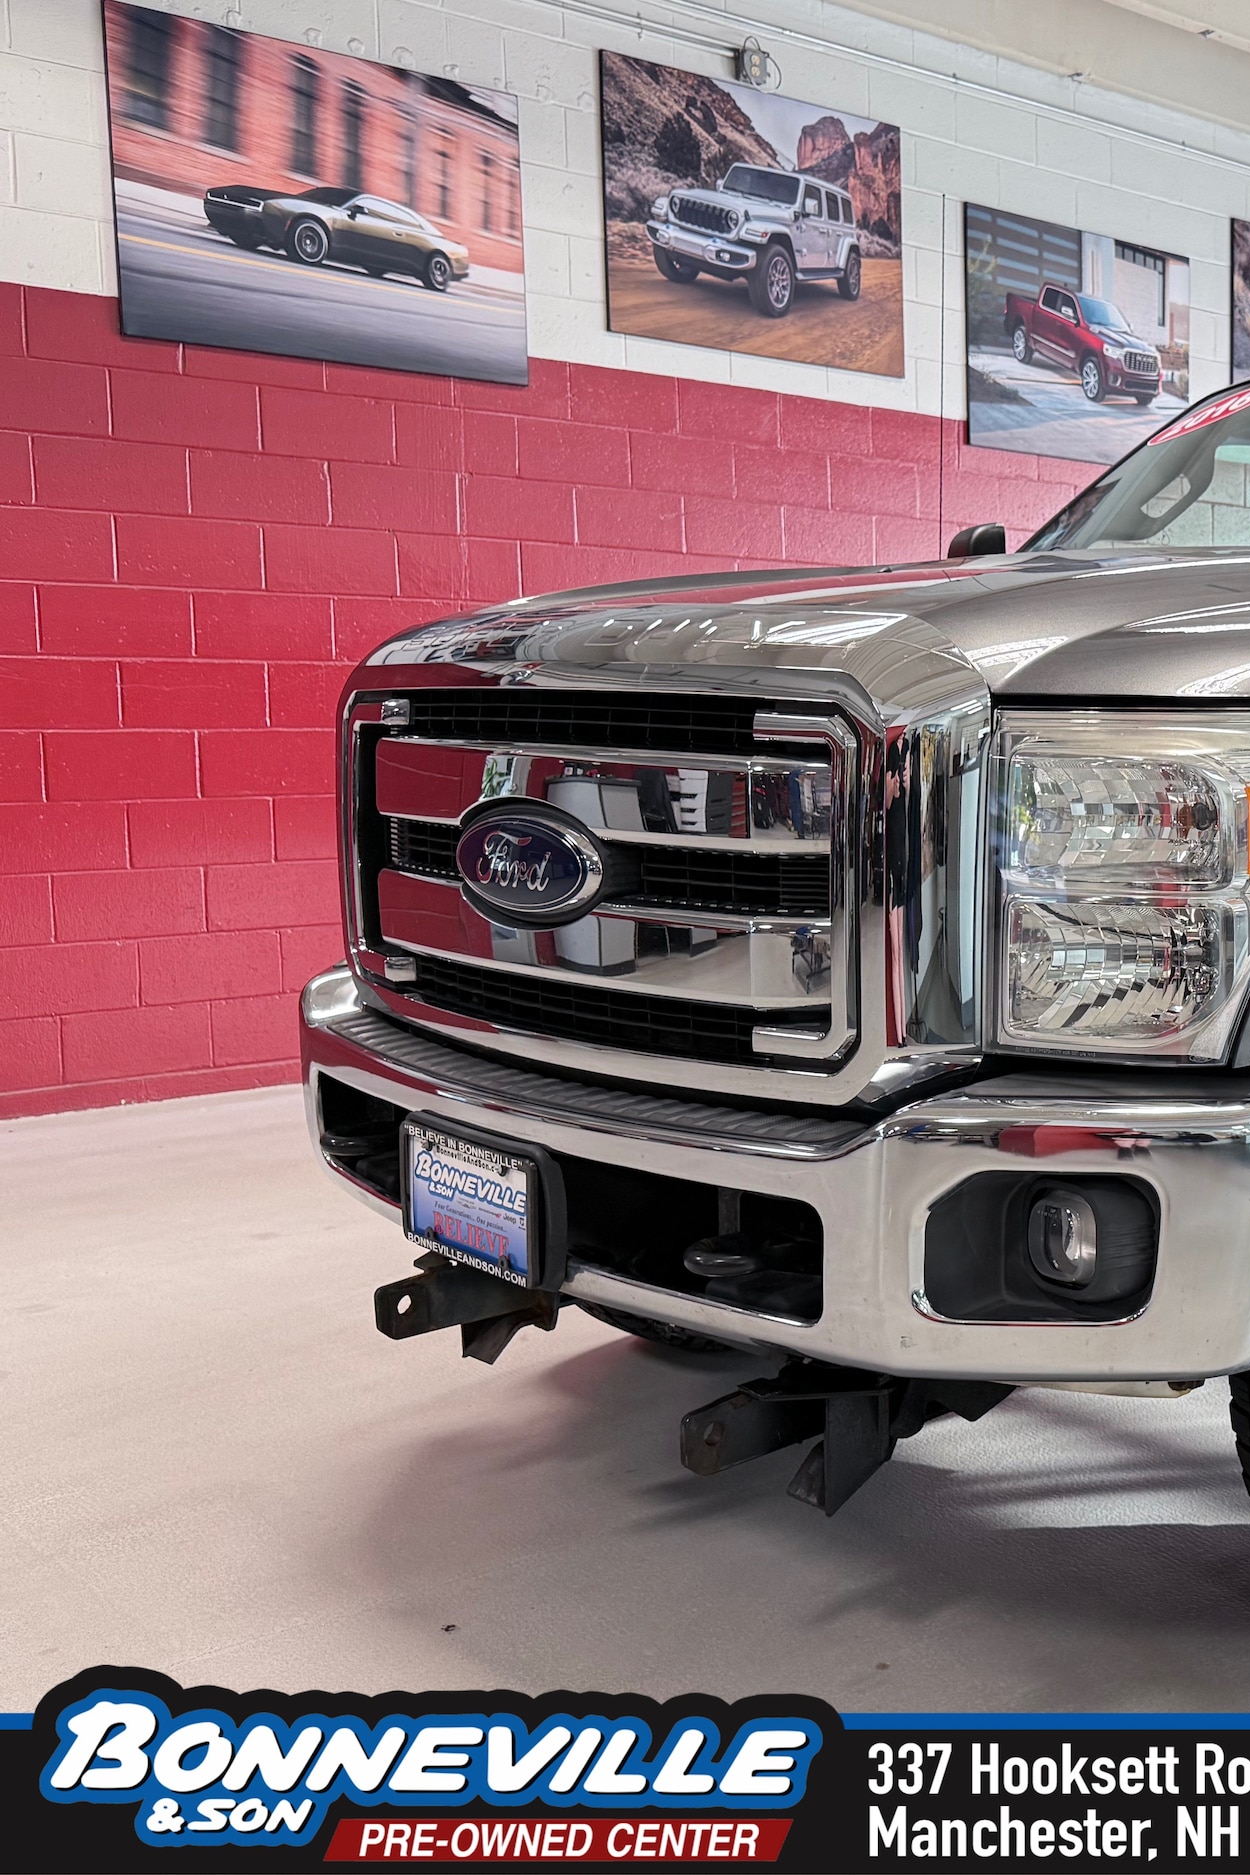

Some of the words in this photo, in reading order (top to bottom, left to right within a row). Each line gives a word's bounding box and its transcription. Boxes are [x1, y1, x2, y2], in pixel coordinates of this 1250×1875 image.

[475, 830, 552, 892] Ford
[436, 1145, 503, 1174] BonnevilleAndSon.c
[447, 1138, 457, 1150] IN
[416, 1153, 527, 1213] BONNEVILLE
[407, 1231, 527, 1288] BONNEVILLEANDSON.COM
[433, 1211, 510, 1259] BELIEVE
